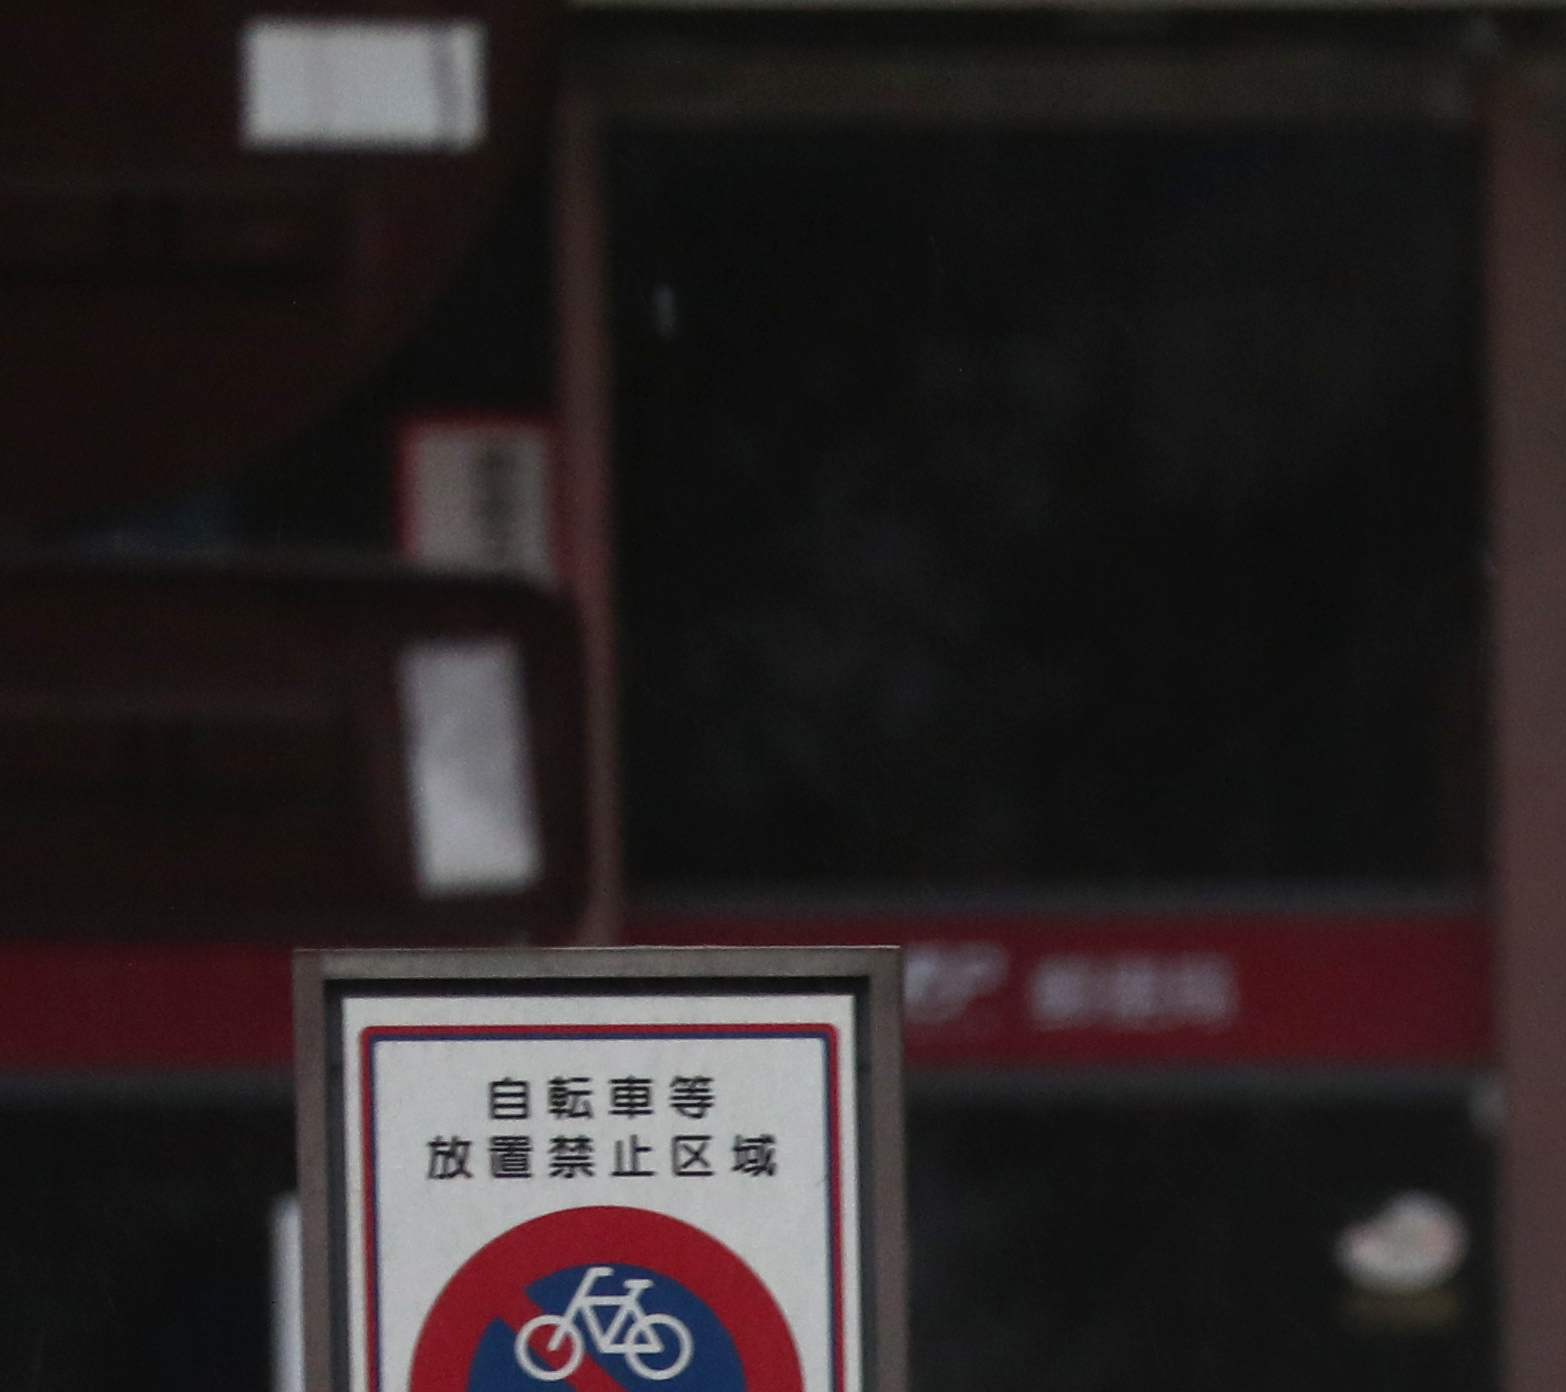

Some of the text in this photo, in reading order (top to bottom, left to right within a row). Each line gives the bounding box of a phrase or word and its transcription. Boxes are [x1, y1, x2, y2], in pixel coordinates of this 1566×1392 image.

[488, 1077, 716, 1121] 自転車等
[427, 1135, 779, 1180] 放置禁止区域
